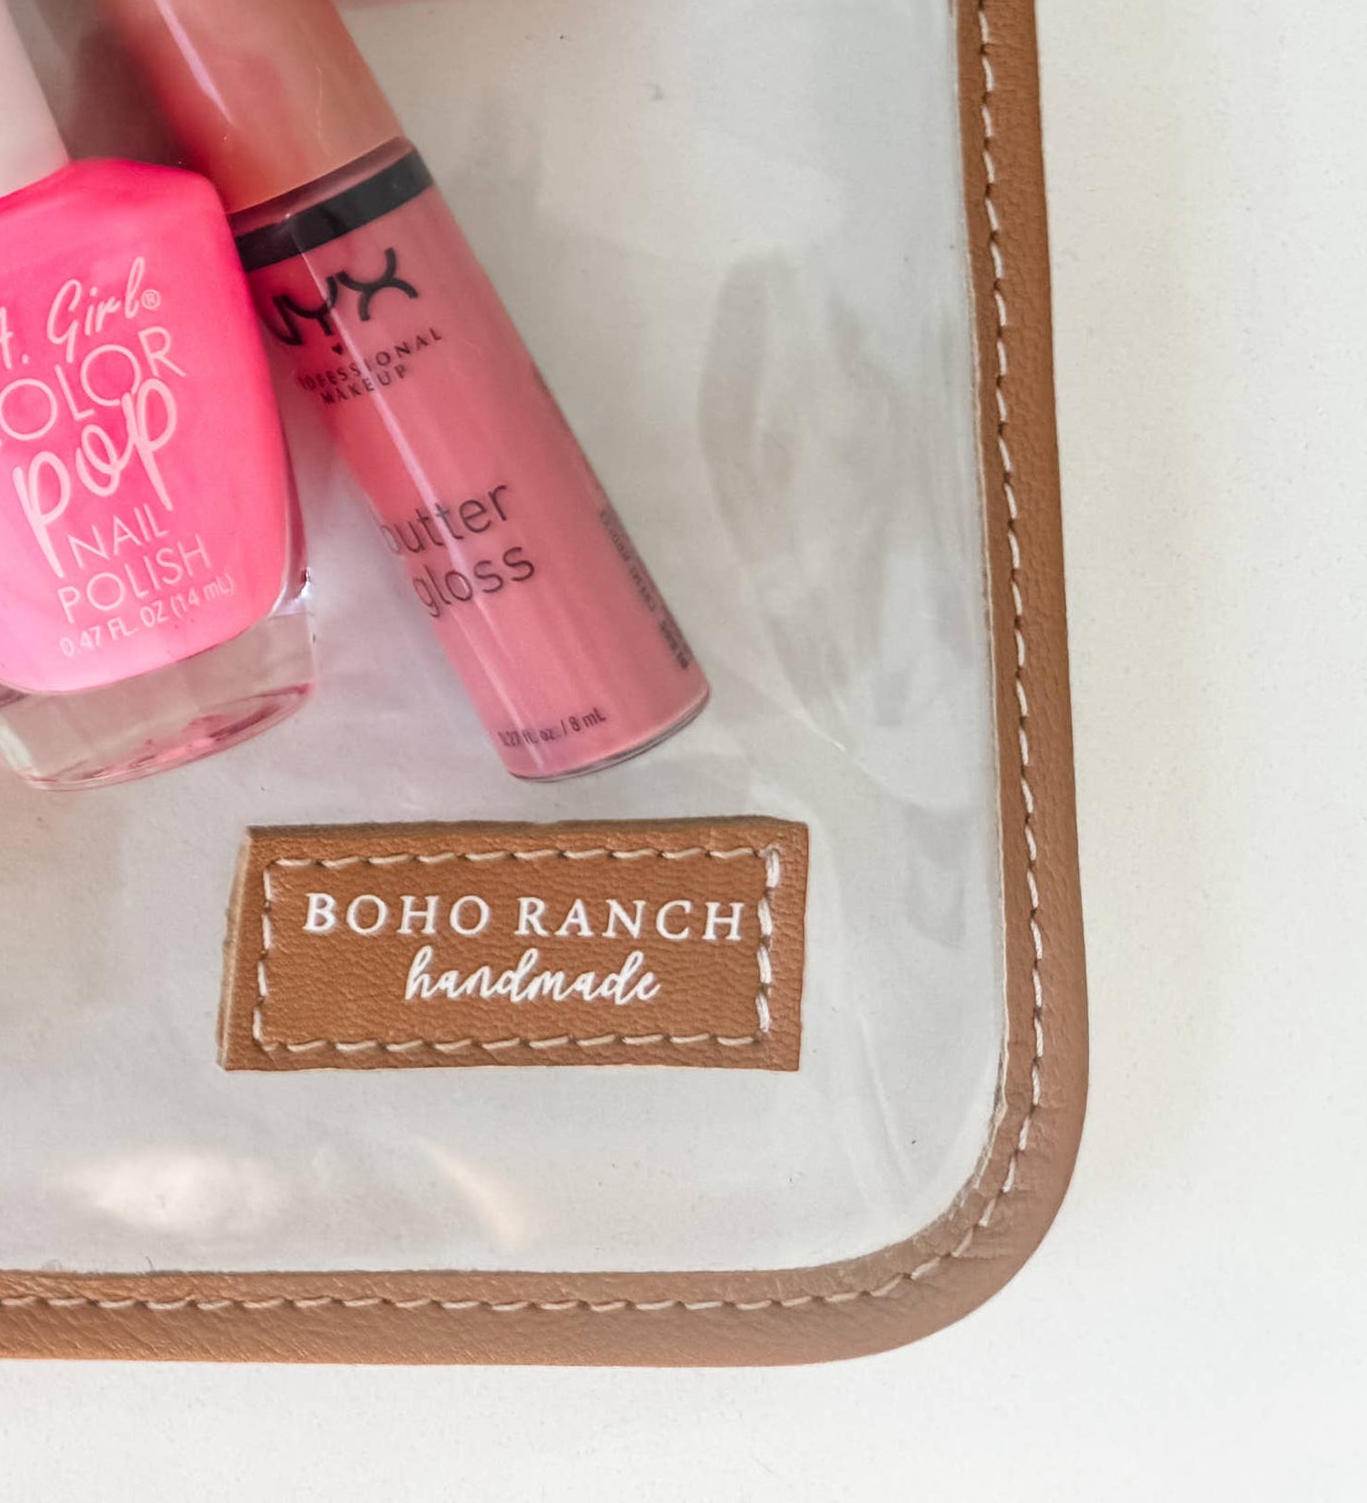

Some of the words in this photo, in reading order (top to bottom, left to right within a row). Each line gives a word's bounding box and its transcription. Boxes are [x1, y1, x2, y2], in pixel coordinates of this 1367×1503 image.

[11, 377, 178, 578] pop
[68, 504, 169, 570] NAIL
[57, 534, 211, 624] POLISH
[139, 600, 169, 628] OZ
[171, 587, 201, 620] (14
[202, 572, 235, 601] mL)
[412, 546, 535, 618] gloss
[568, 715, 581, 732] 8
[582, 707, 607, 729] mL
[302, 891, 491, 936] BOHO
[515, 896, 746, 942] RANCH
[403, 944, 662, 1005] handmade
